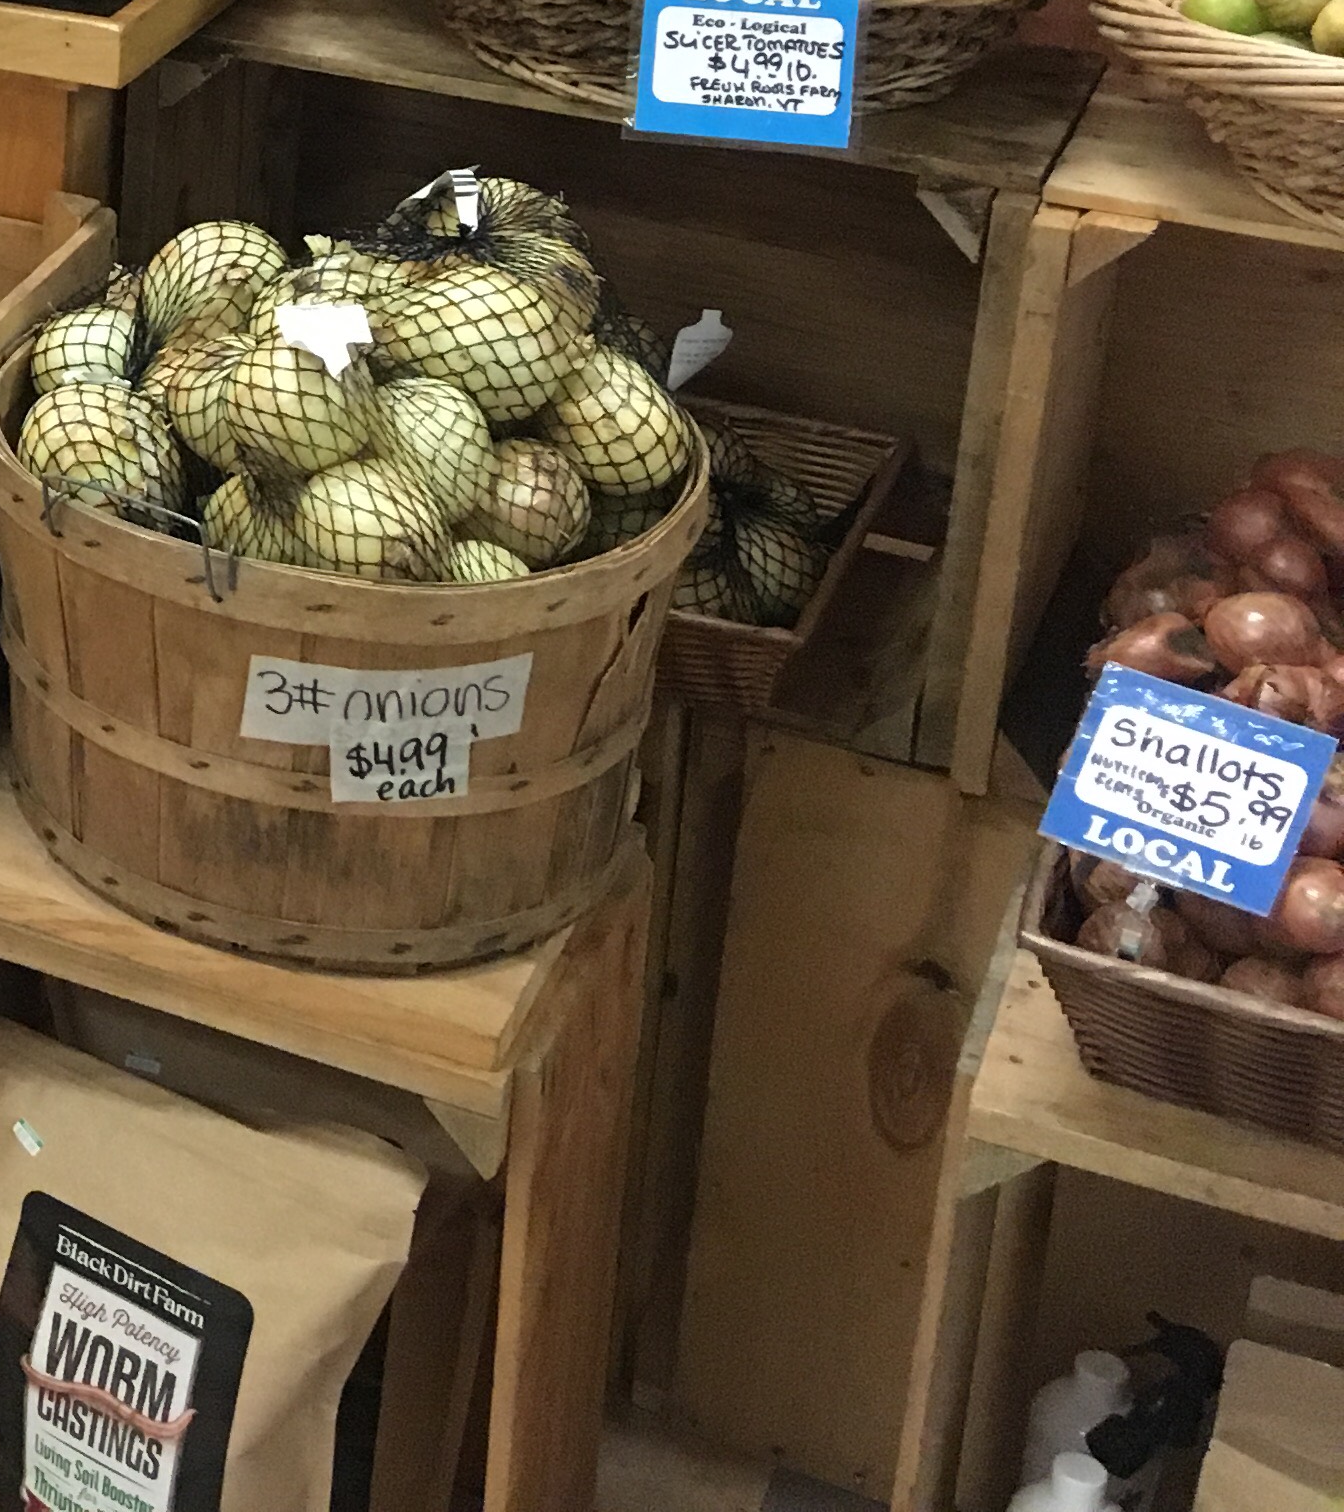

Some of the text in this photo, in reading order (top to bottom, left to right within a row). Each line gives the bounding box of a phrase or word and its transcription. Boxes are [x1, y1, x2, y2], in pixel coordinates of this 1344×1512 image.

[692, 13, 807, 35] Eco Logical
[776, 98, 805, 112] VT
[256, 670, 511, 724] 3# onions
[345, 731, 449, 781] $4.99
[1109, 717, 1286, 802] Shallots
[375, 767, 456, 802] each
[1169, 781, 1294, 834] $5.99
[1137, 798, 1217, 839] Organic
[1083, 814, 1236, 894] LOCAL
[58, 1282, 182, 1365] High Potency
[44, 1311, 179, 1425] WORM
[36, 1384, 164, 1482] CASTINGS
[33, 1432, 73, 1480] Living
[73, 1458, 101, 1493] Soil
